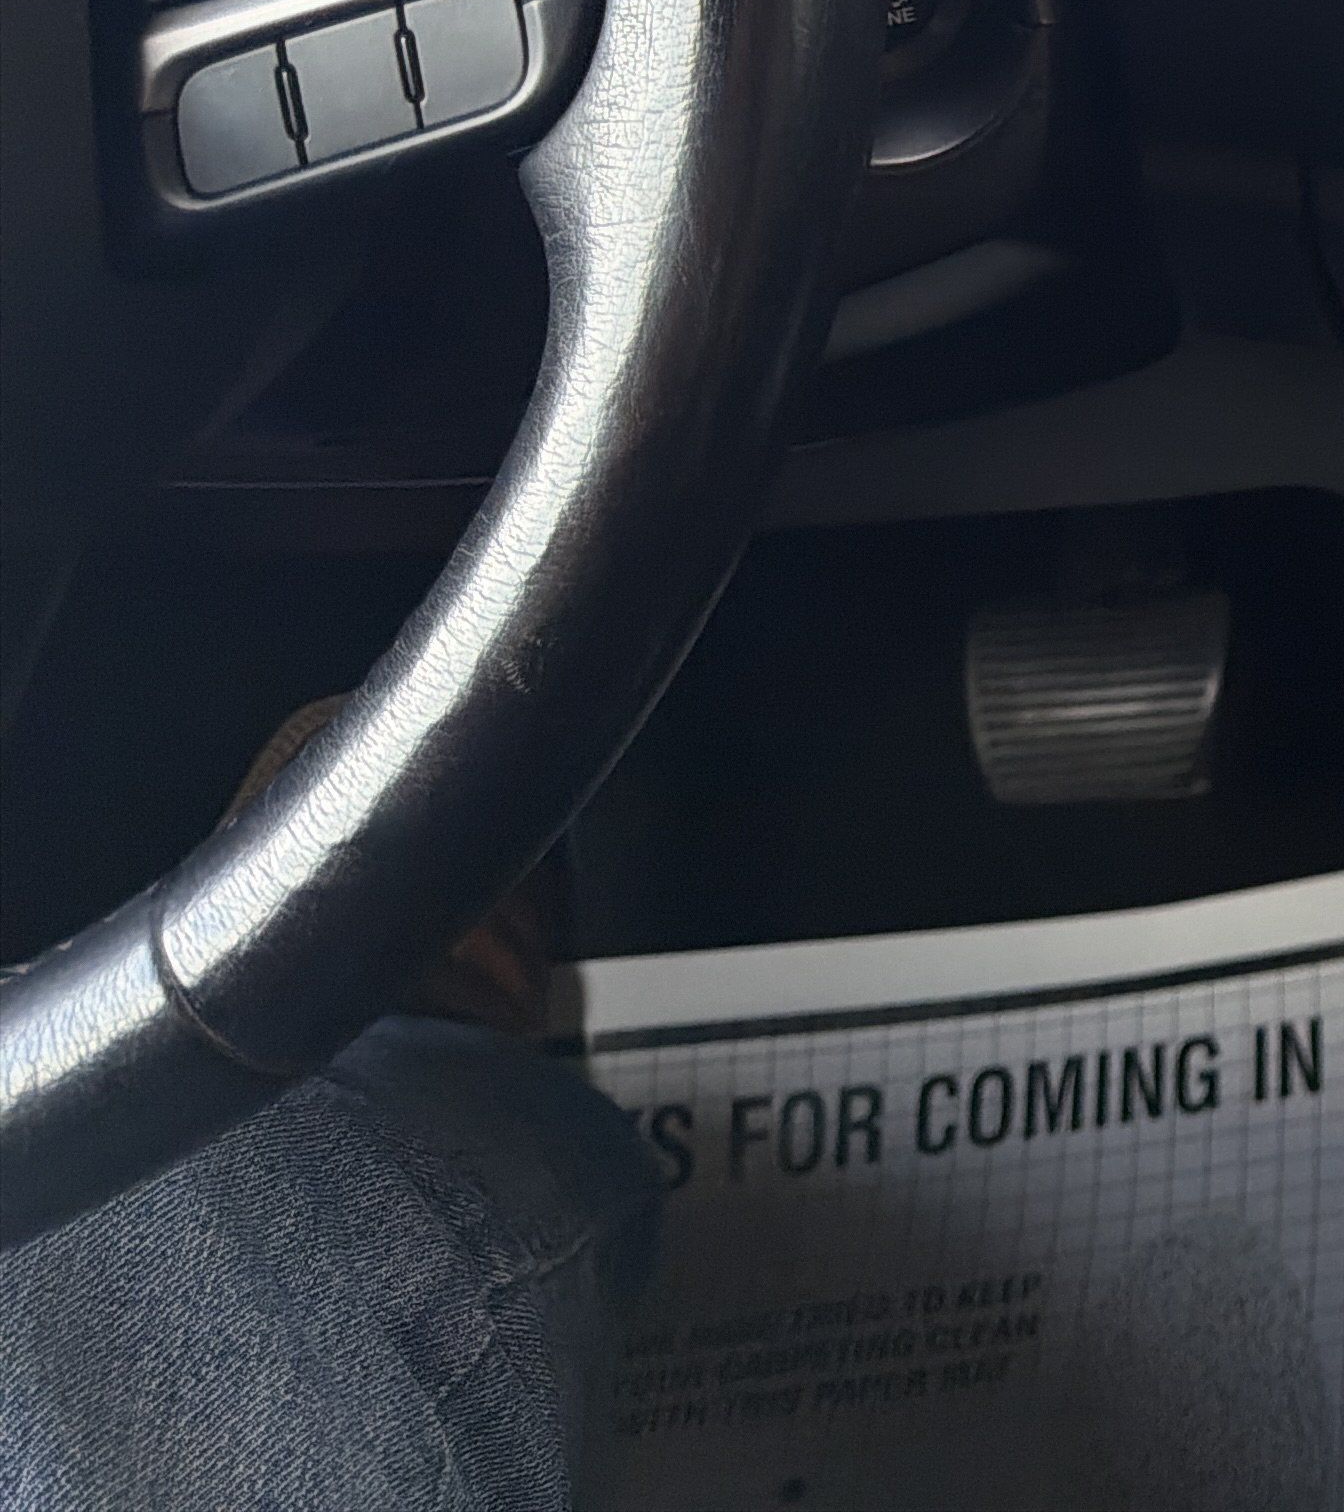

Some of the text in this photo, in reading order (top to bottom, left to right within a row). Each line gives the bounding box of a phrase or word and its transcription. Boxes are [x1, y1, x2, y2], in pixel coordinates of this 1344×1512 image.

[727, 1084, 884, 1185] FOR
[915, 1035, 1219, 1156] COMING
[1254, 1017, 1323, 1101] IN
